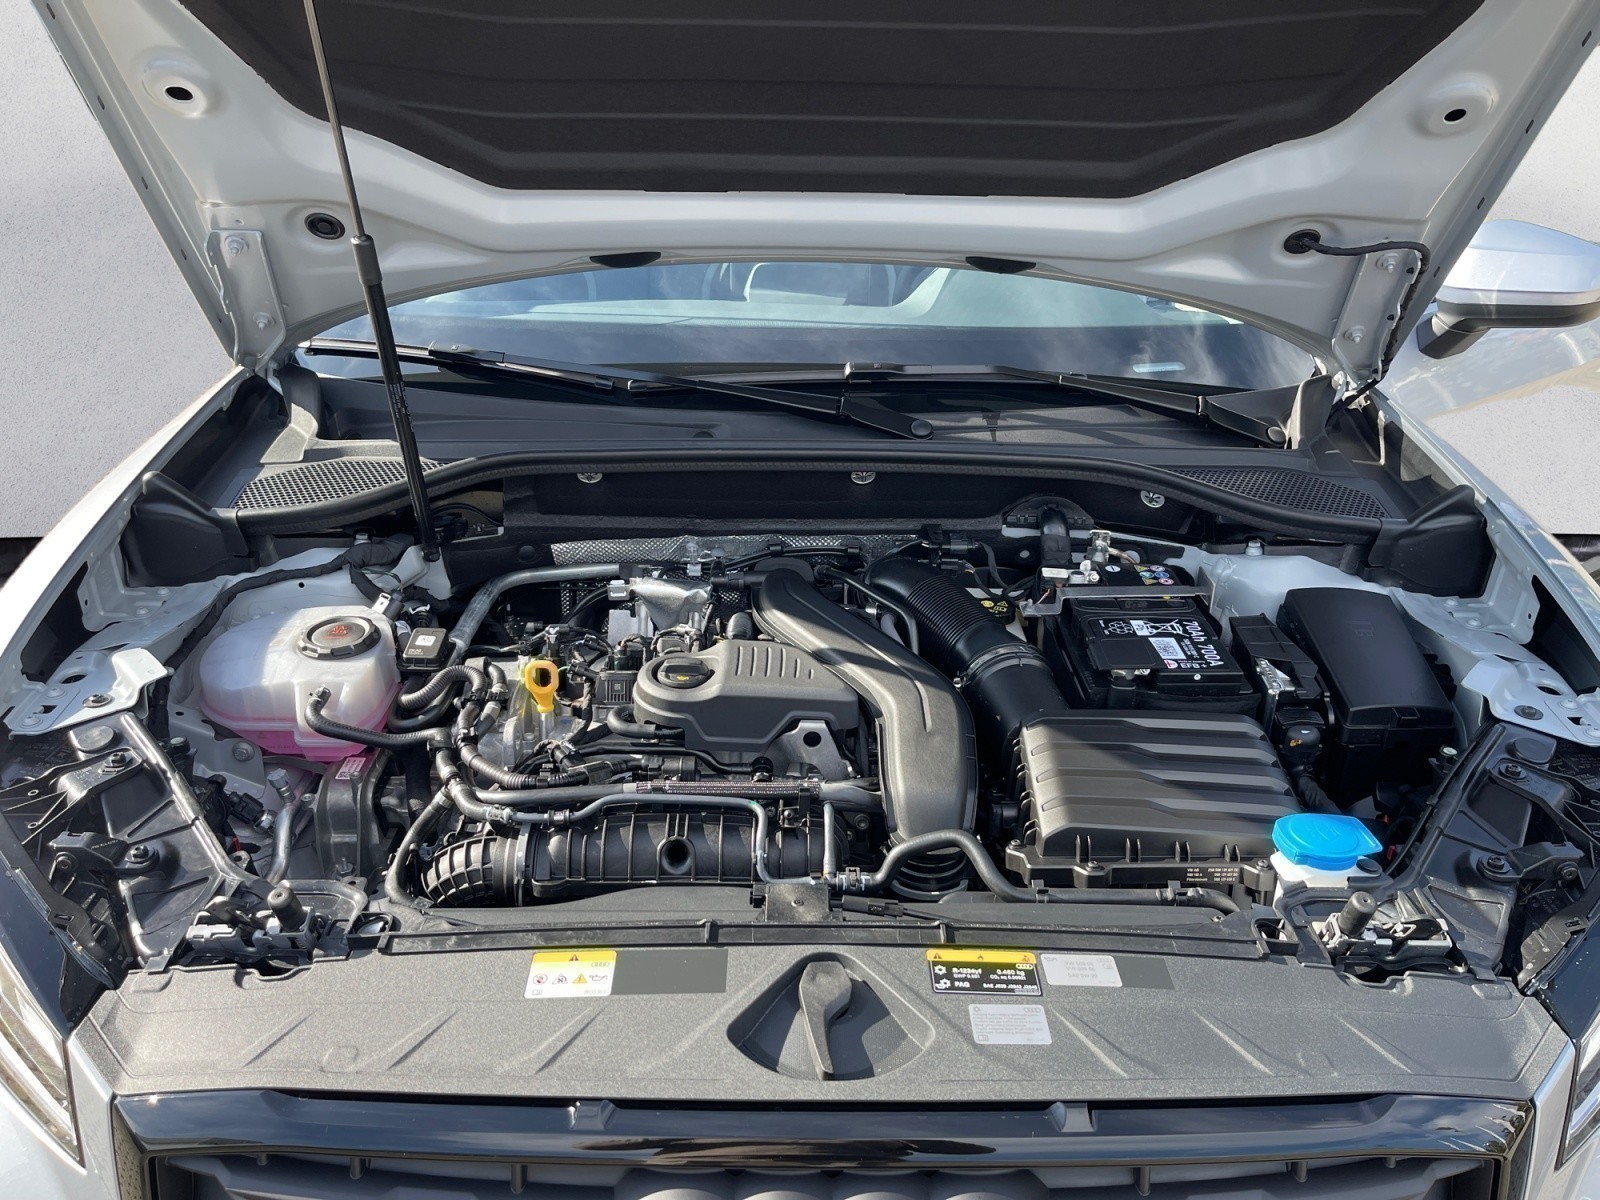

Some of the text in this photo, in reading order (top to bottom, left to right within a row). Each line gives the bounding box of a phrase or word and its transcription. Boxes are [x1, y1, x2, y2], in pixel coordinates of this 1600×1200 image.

[1183, 621, 1207, 641] 70Ah
[1198, 644, 1224, 666] 700A
[952, 967, 982, 975] R-1234yf
